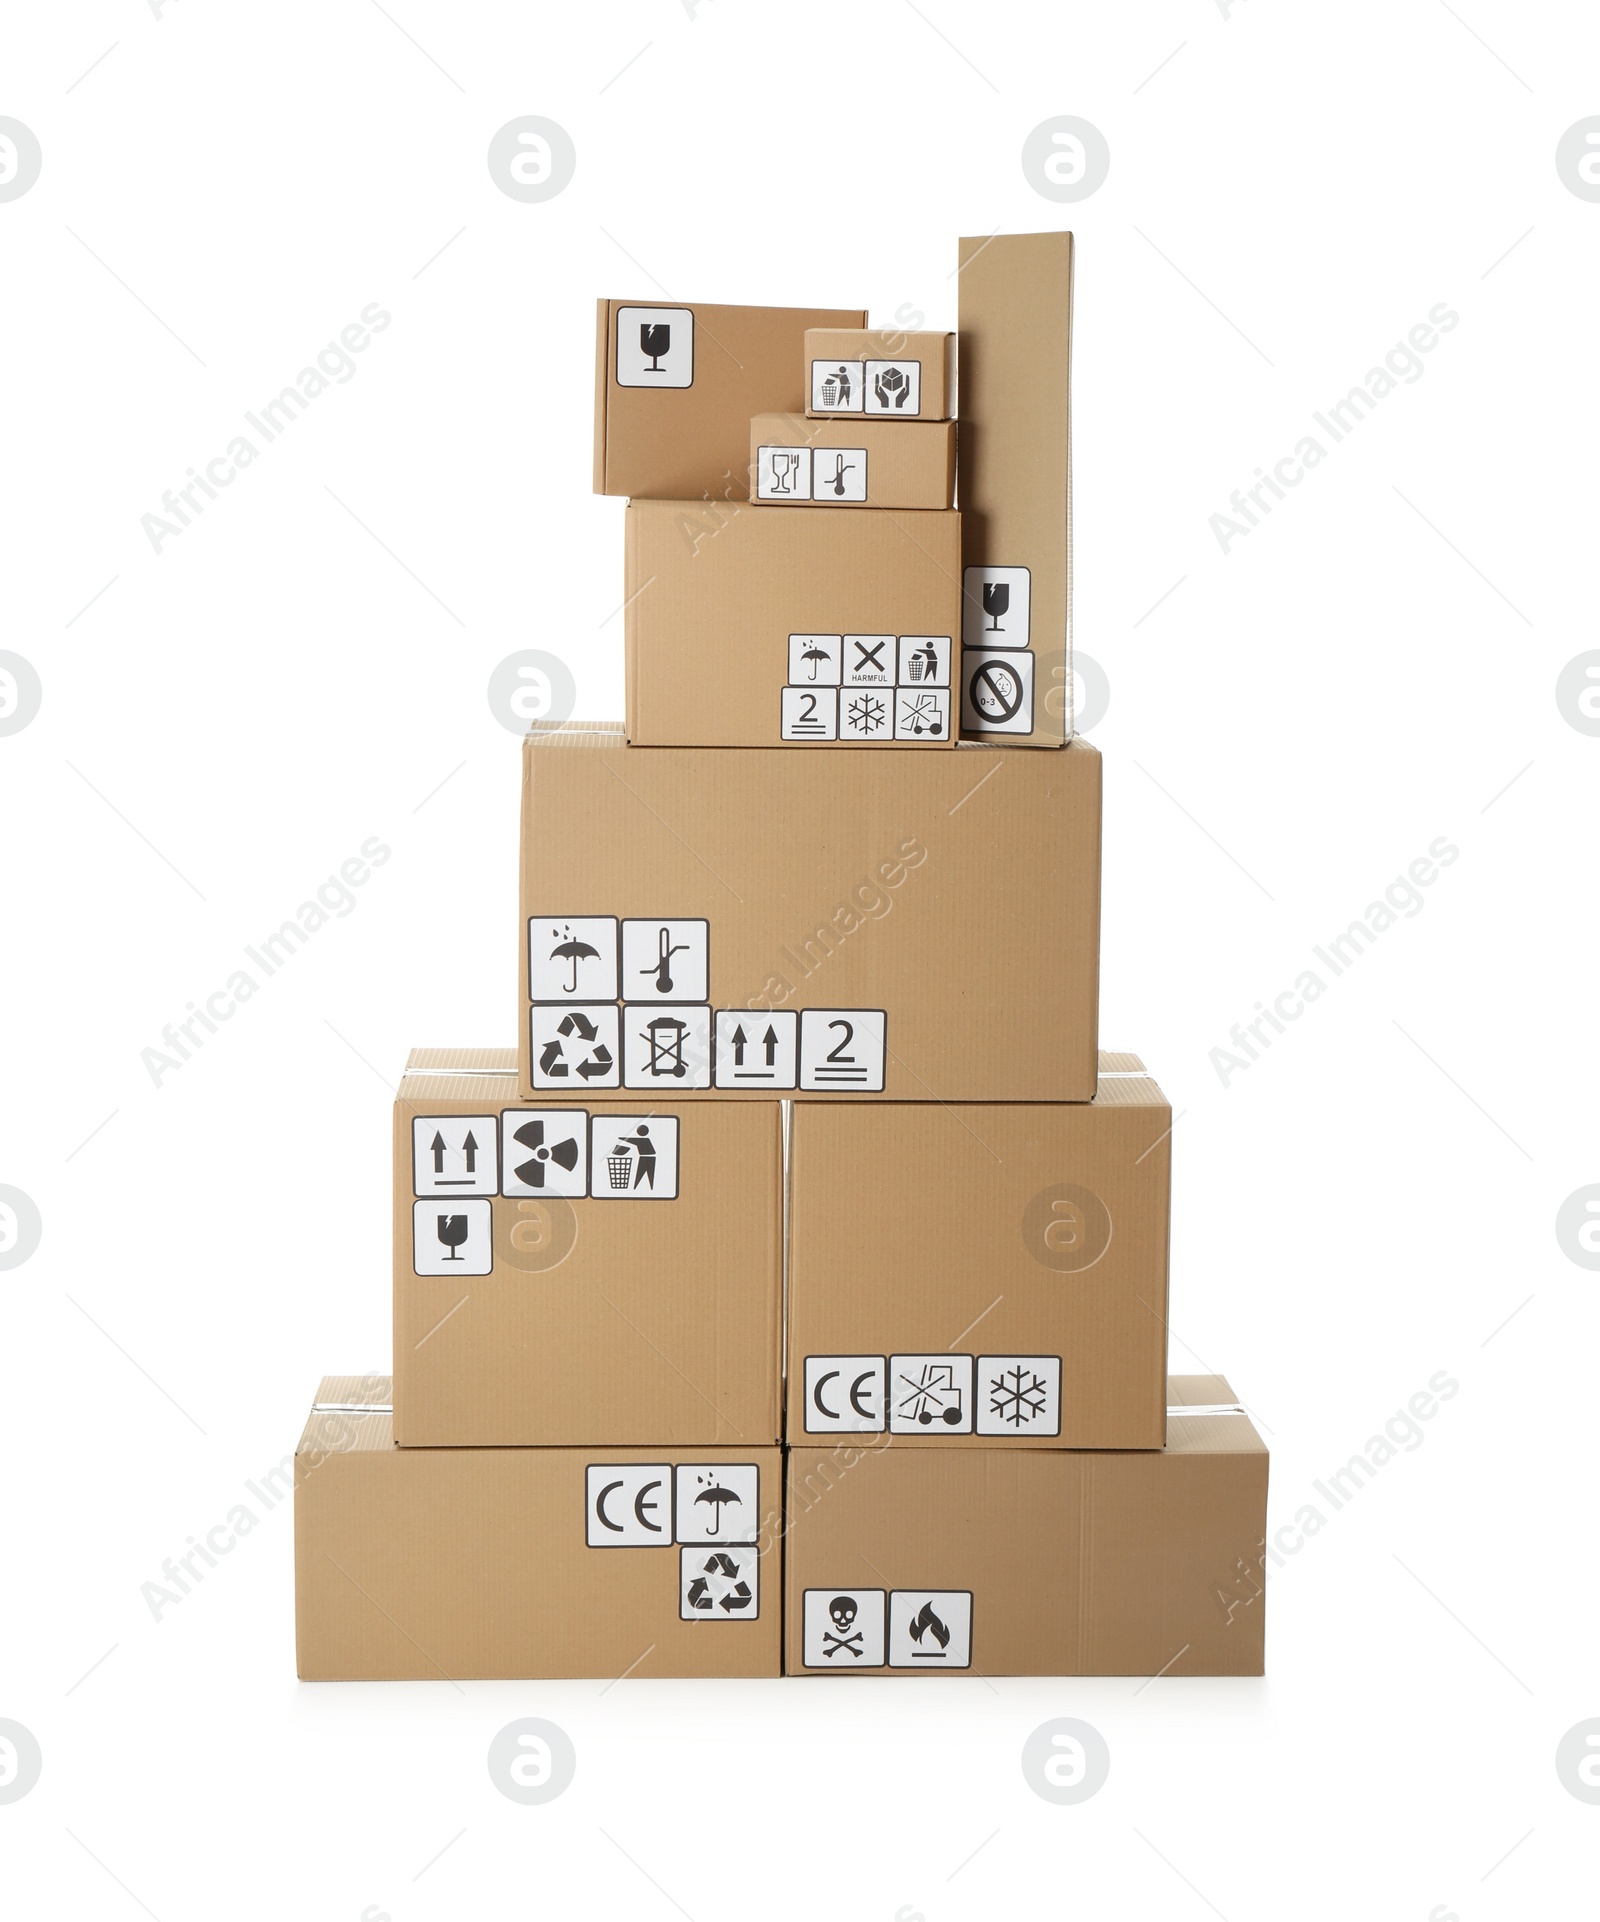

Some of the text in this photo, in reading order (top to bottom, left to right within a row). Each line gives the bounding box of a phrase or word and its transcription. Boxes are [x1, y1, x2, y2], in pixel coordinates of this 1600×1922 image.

[851, 674, 888, 683] HARMFUL
[799, 693, 818, 722] 2
[980, 697, 996, 706] 0-3
[826, 1019, 855, 1063] 2
[813, 1370, 876, 1419] CE
[596, 1480, 662, 1532] CE
